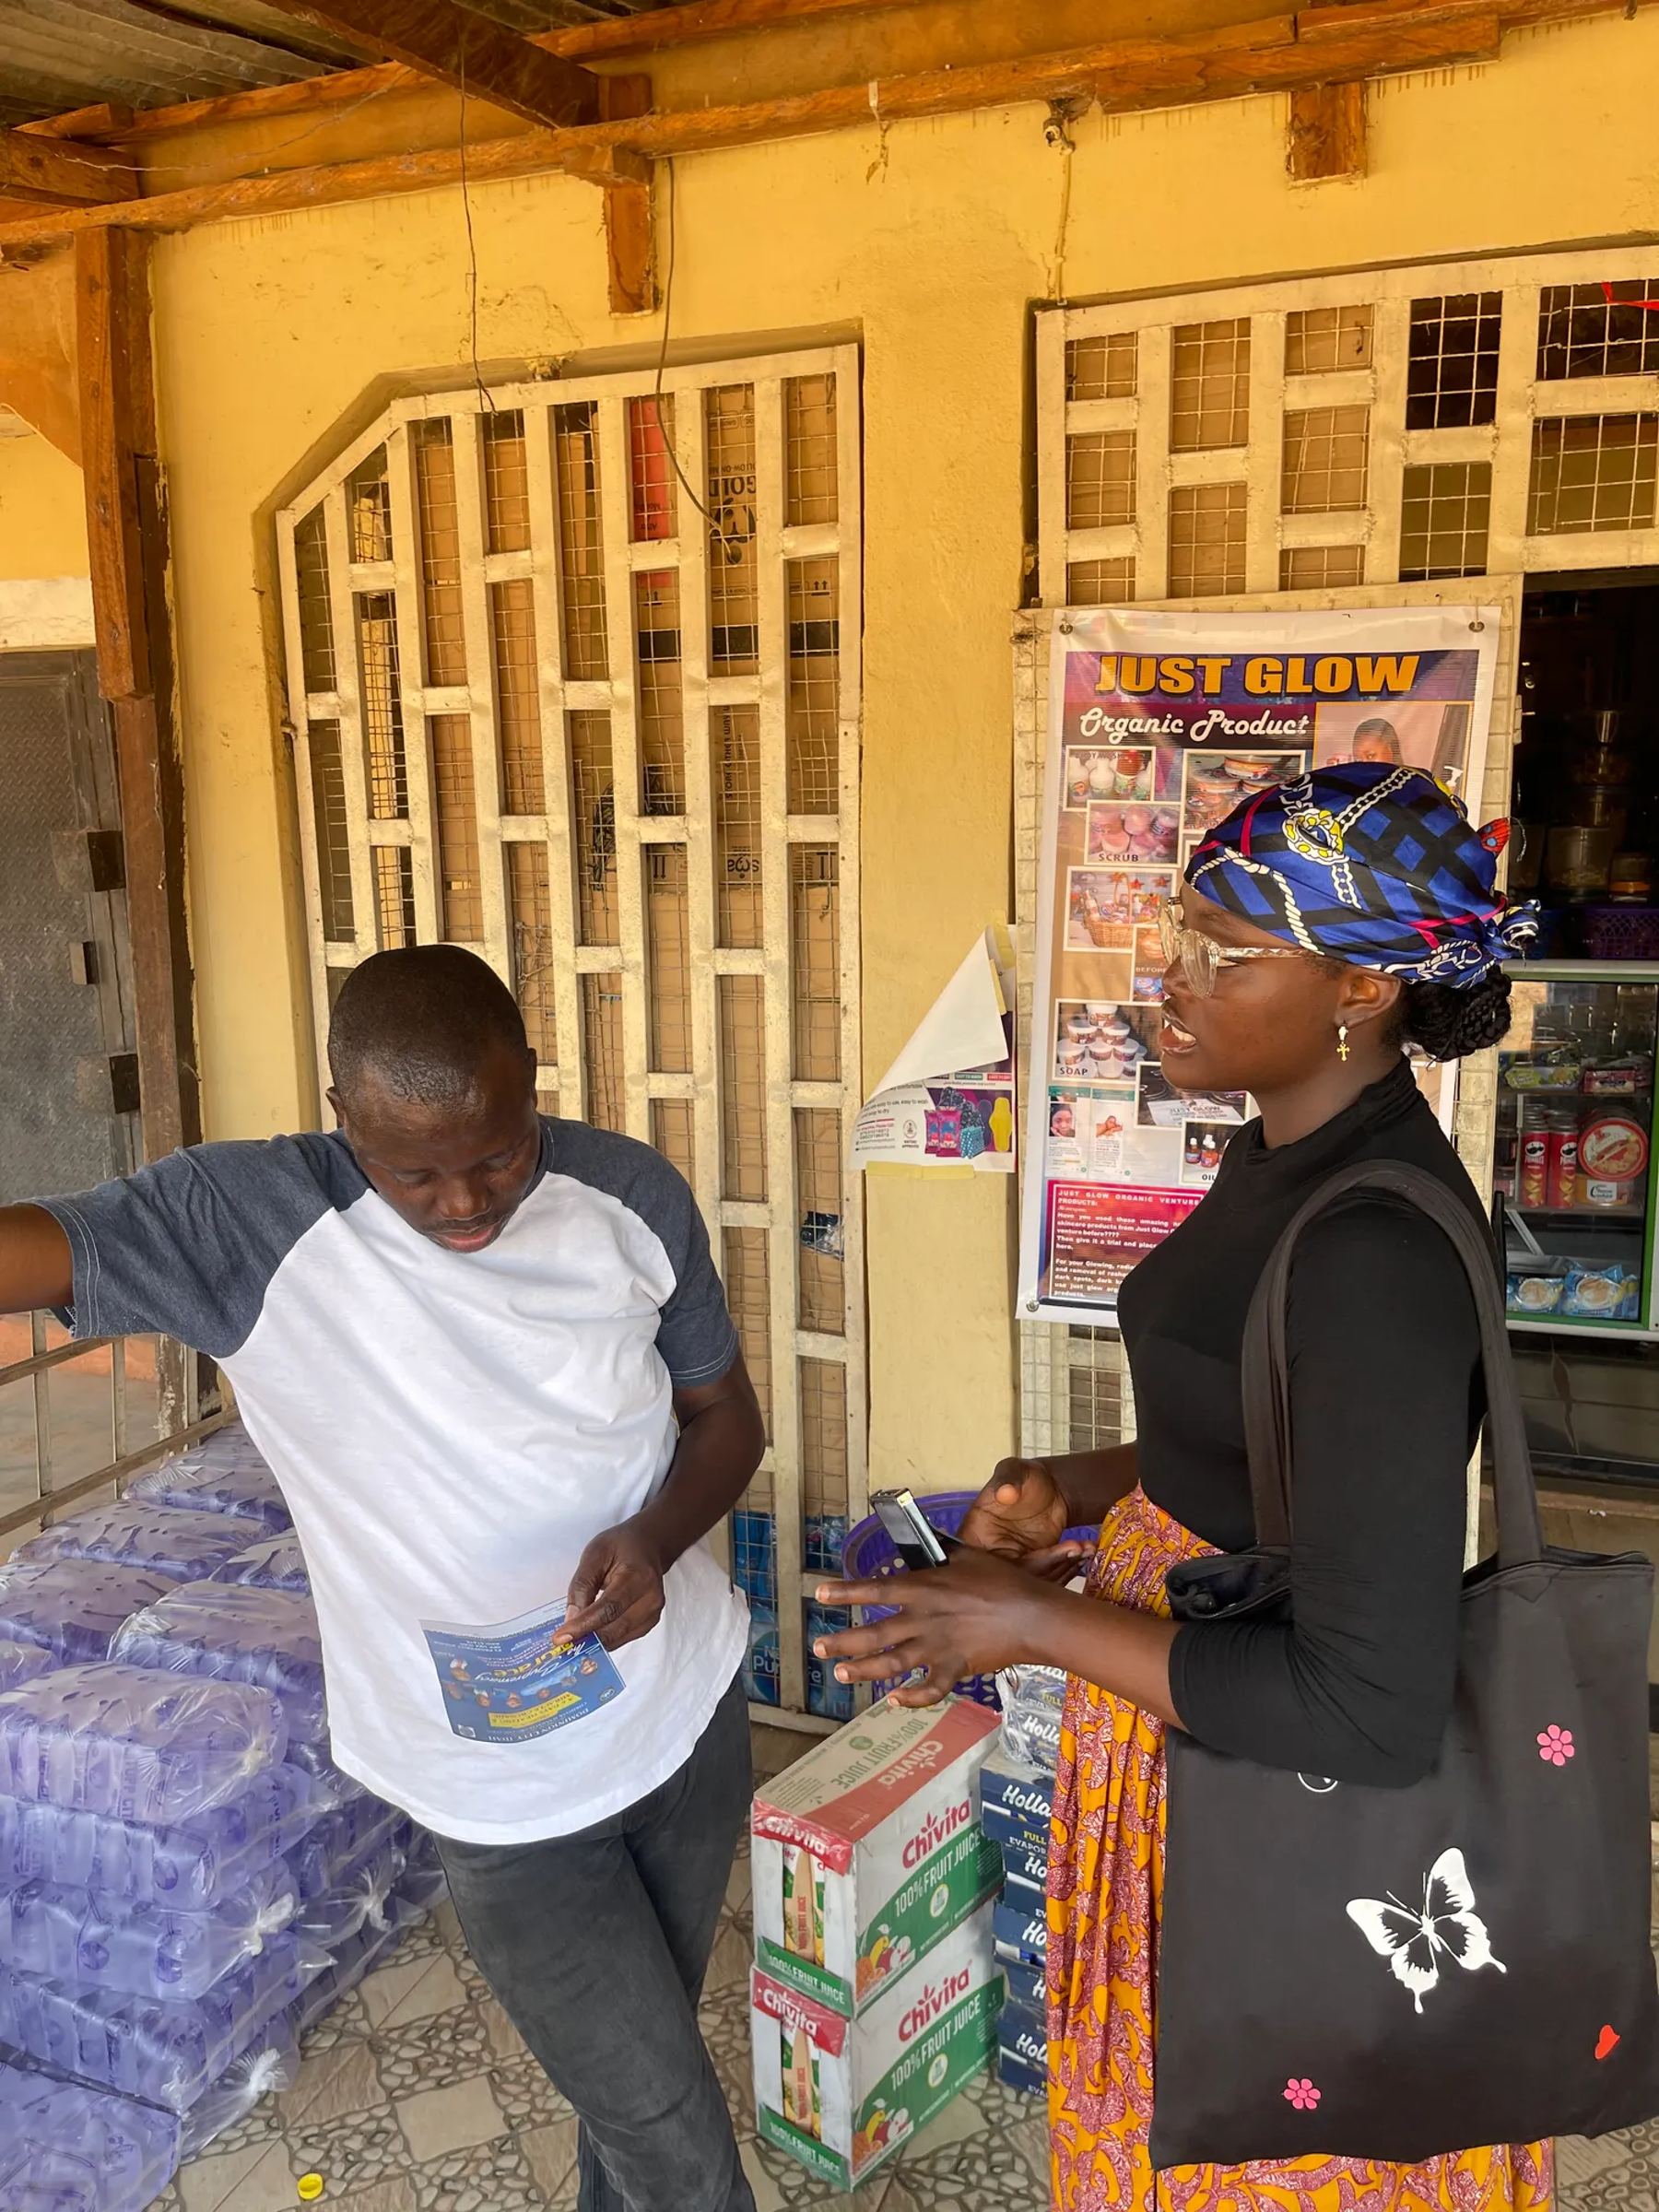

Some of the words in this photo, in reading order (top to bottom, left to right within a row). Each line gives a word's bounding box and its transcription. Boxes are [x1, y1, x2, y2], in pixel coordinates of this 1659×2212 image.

[1096, 655, 1231, 695] JUST
[1245, 655, 1419, 694] GLOW
[1079, 706, 1184, 745] Organic
[1190, 710, 1309, 741] Product
[1099, 853, 1139, 863] SCRUB
[1059, 1066, 1088, 1077] SOAP
[1087, 1222, 1117, 1230] products
[830, 1759, 869, 1790] JUICE
[877, 1739, 944, 1789] Chivita
[902, 1799, 971, 1869] Chivita
[954, 1827, 982, 1866] JUICE
[1024, 1830, 1047, 1845] FULL
[762, 1988, 818, 2036] Chivita
[898, 1967, 971, 2041] Chivita
[953, 1994, 982, 2035] JUICE
